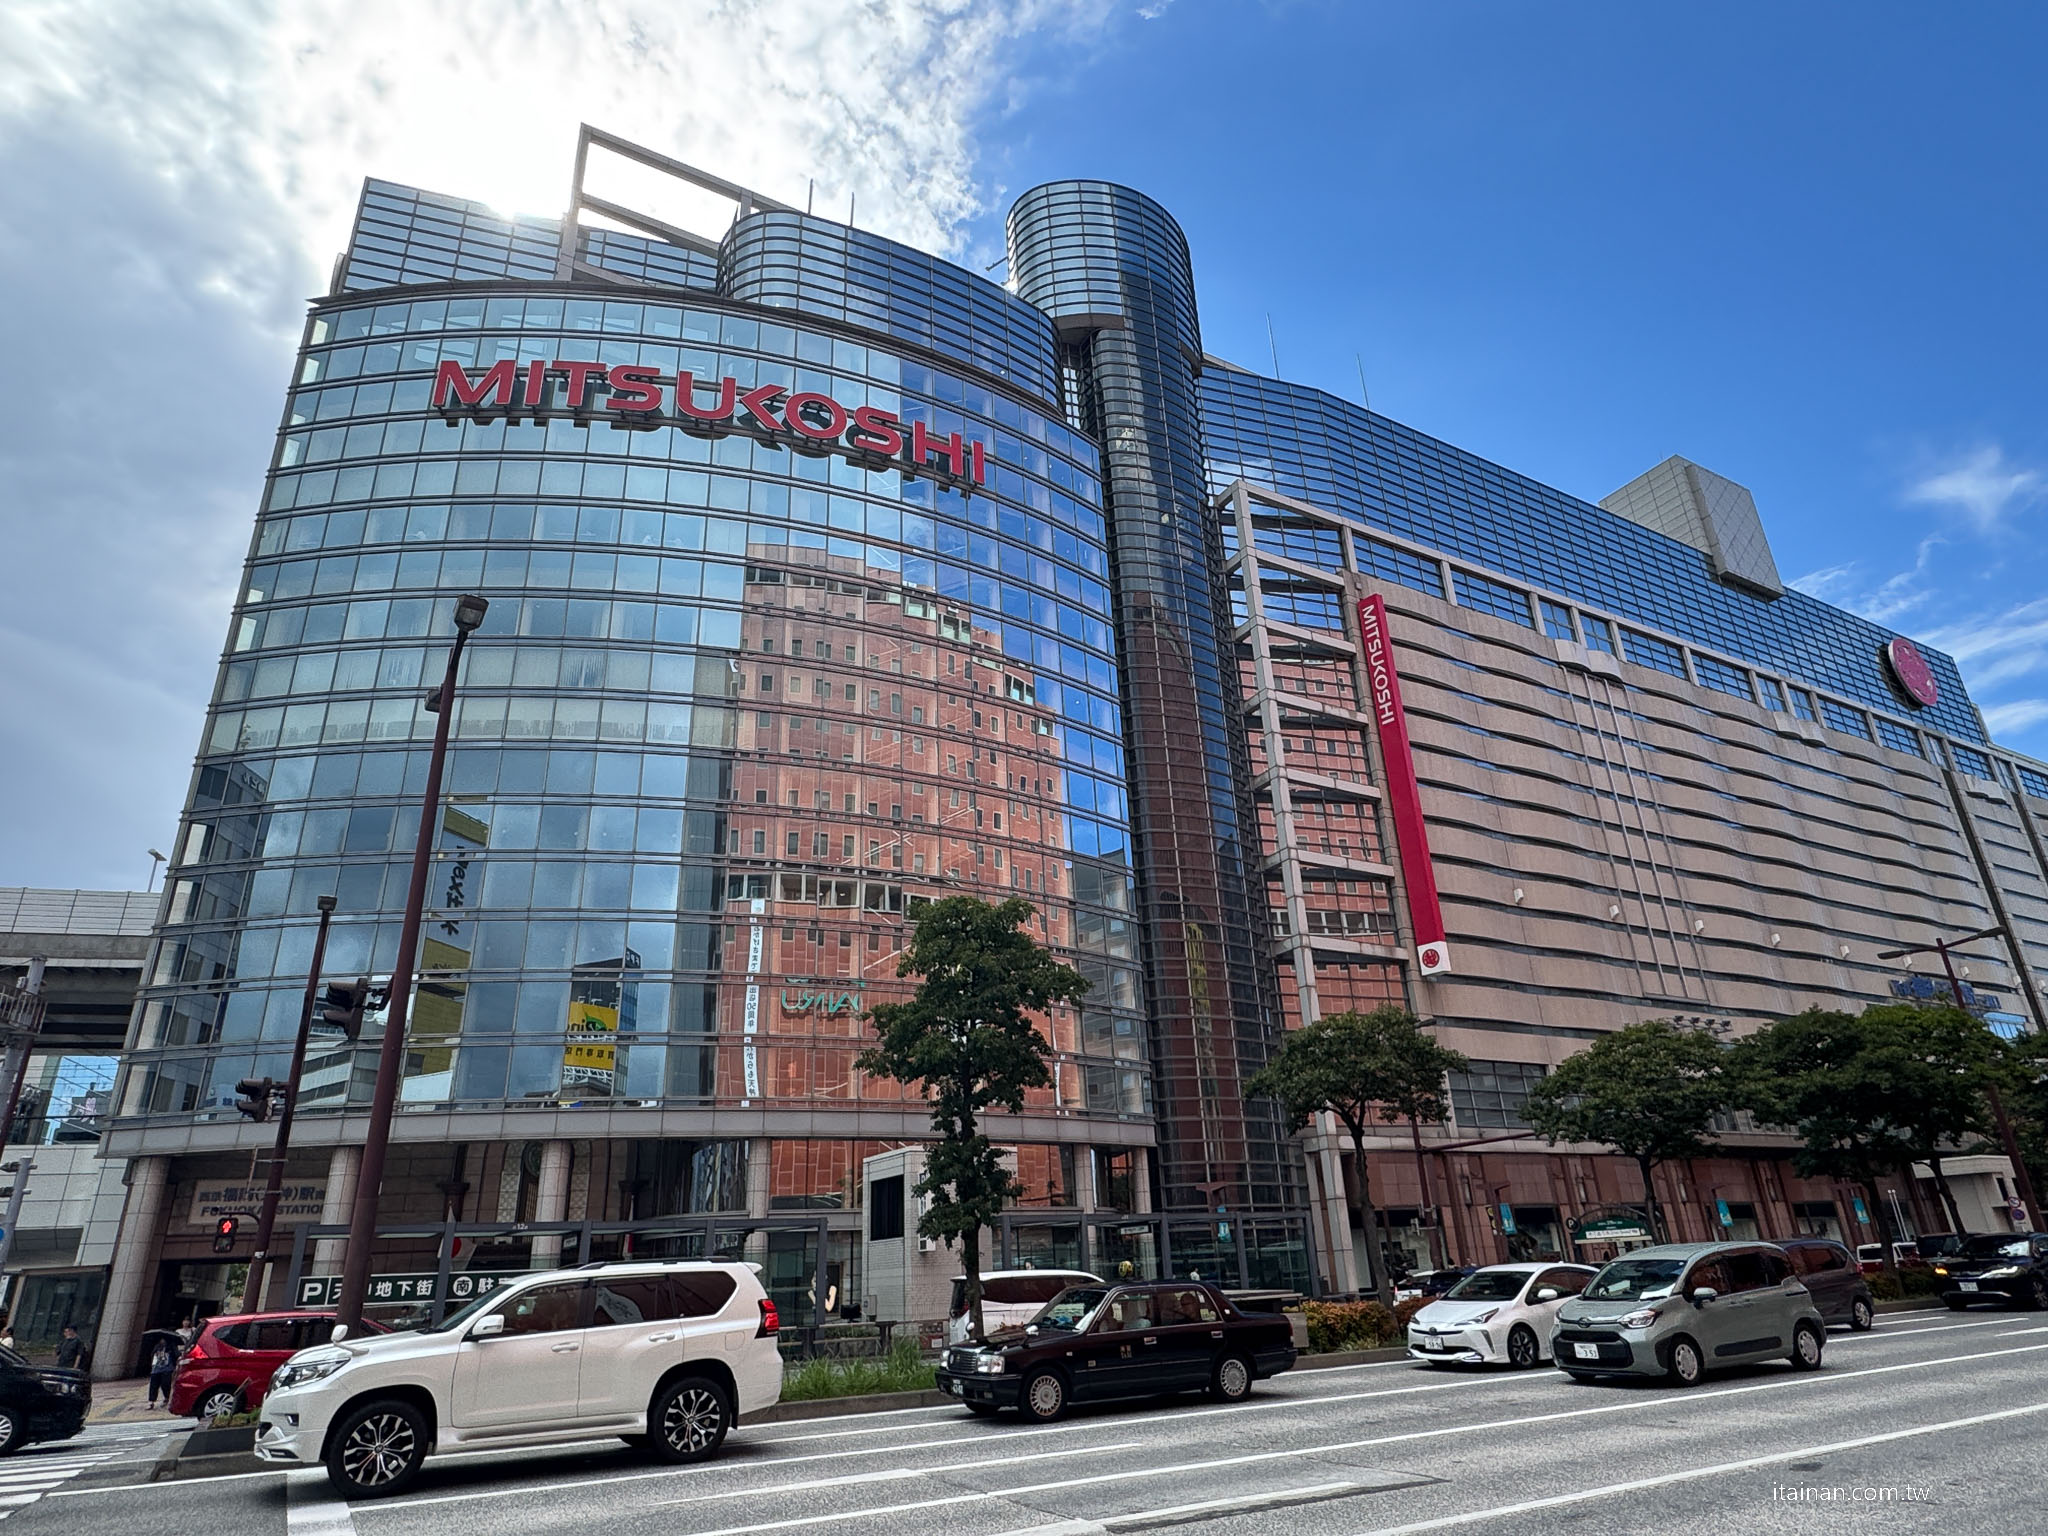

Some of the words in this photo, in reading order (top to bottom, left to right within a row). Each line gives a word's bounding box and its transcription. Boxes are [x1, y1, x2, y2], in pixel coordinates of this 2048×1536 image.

[433, 359, 986, 485] MITSUKOSHI
[1362, 604, 1395, 726] MITSUKOSHI
[275, 1203, 324, 1216] STATIO
[302, 1282, 323, 1303] P
